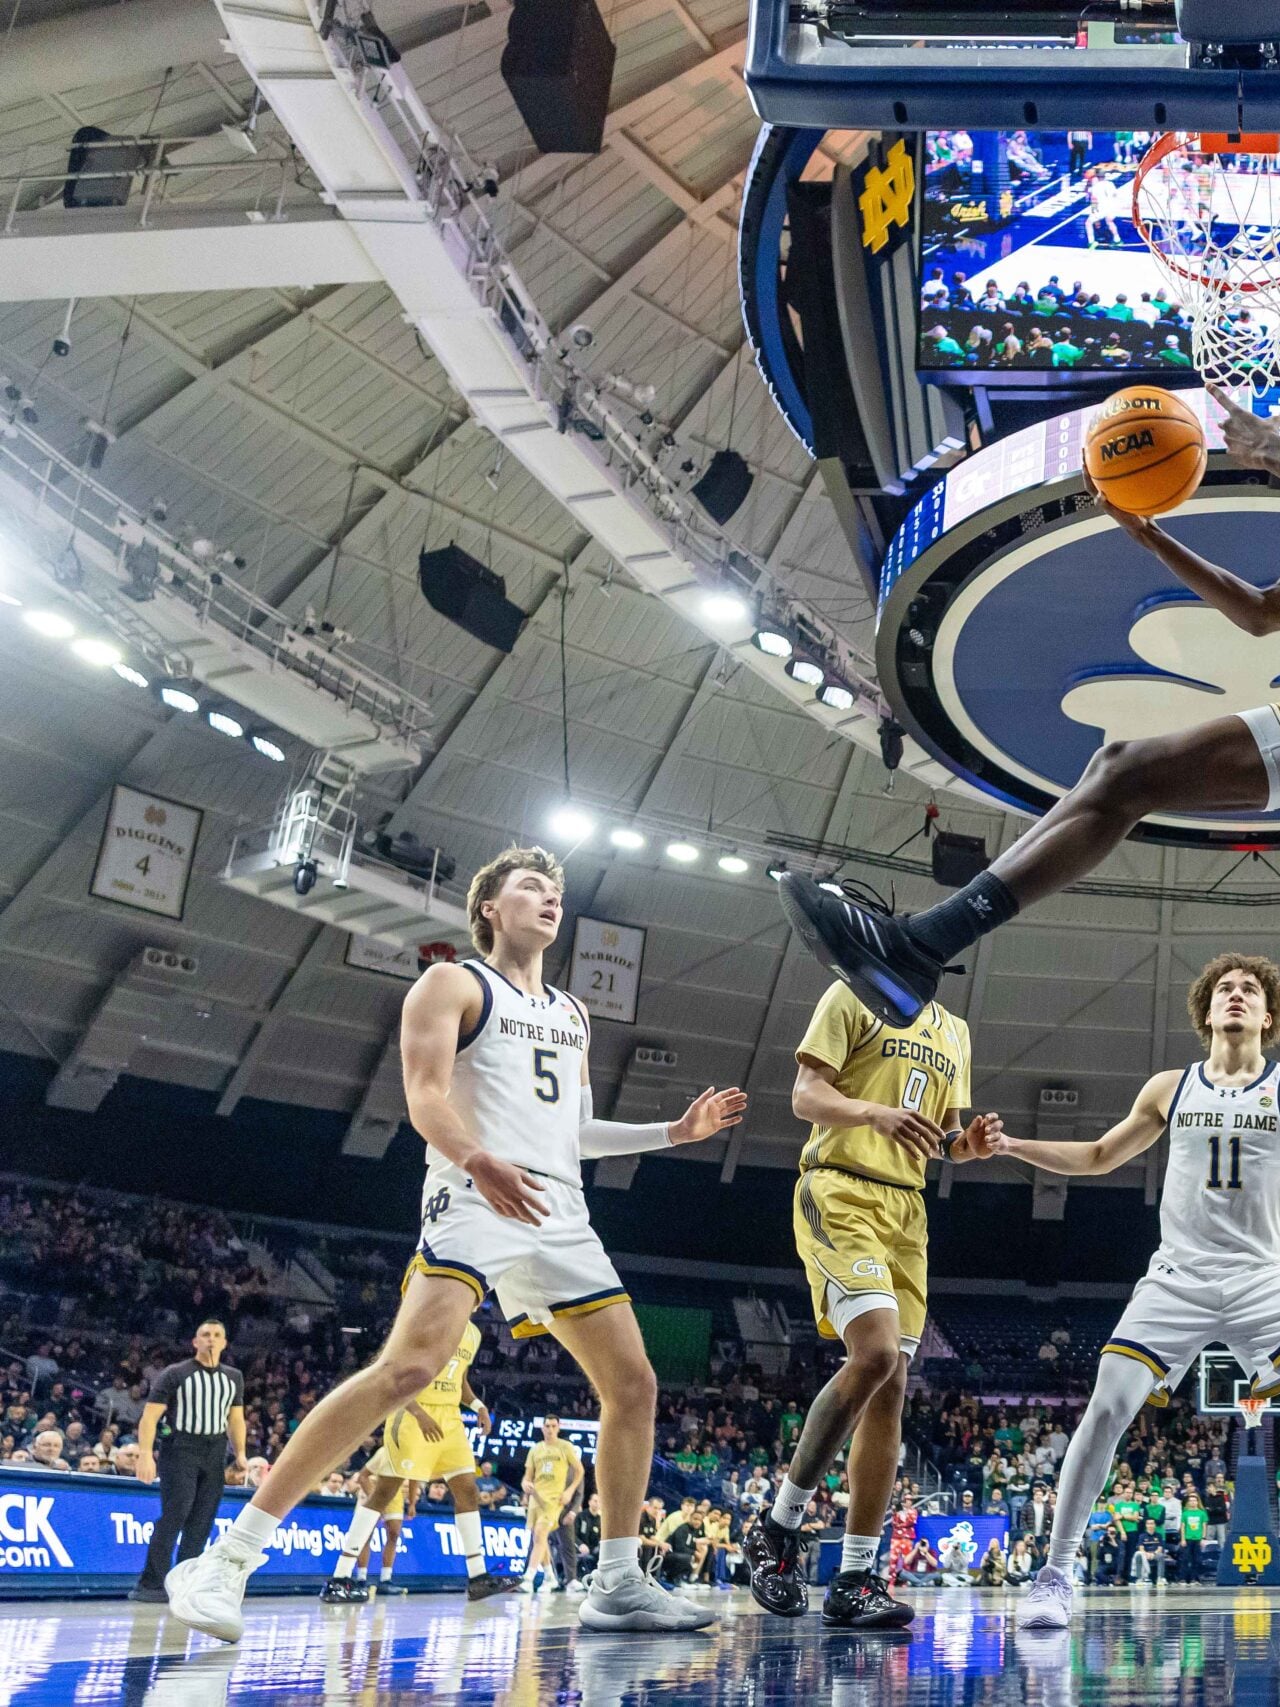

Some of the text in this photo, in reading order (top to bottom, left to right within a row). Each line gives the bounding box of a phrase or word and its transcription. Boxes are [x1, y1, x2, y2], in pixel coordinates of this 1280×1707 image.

[1101, 429, 1154, 462] NCAA
[136, 855, 150, 877] 4
[591, 969, 616, 992] 21
[499, 1016, 585, 1052] NOTRE DAME
[533, 1046, 560, 1105] 5
[881, 1038, 957, 1086] GEORGIA
[902, 1067, 928, 1112] 0
[1177, 1112, 1277, 1132] NOTRE DAME
[1206, 1135, 1243, 1190] 11
[852, 1257, 887, 1280] GT
[447, 1360, 460, 1380] 7
[500, 1419, 534, 1439] 15:21
[0, 1493, 74, 1567] CK
[110, 1512, 154, 1545] The
[266, 1521, 324, 1557] uying
[1232, 1535, 1272, 1573] ND
